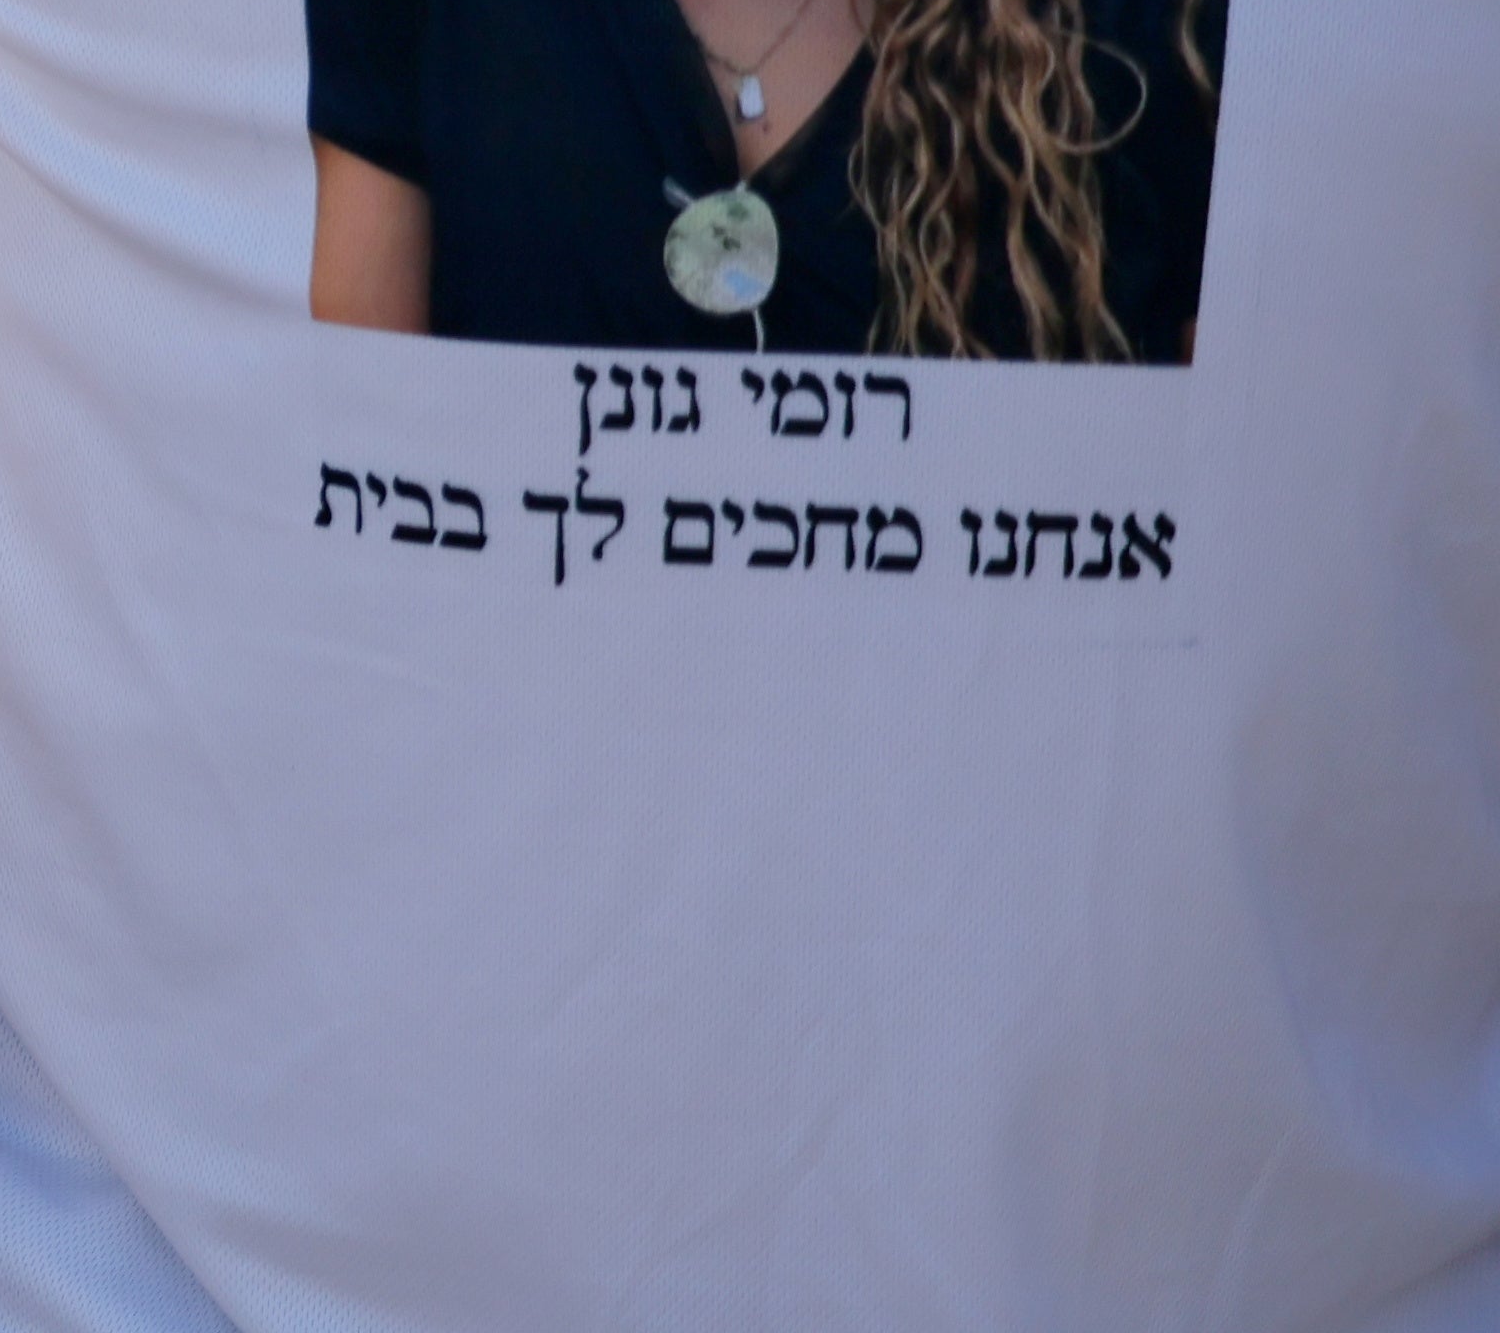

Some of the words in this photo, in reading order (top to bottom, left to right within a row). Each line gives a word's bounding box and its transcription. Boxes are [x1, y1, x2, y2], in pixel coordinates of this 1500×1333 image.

[573, 361, 700, 455] גונן
[741, 368, 912, 440] רומי
[313, 462, 487, 551] בבית
[522, 466, 625, 586] לך
[663, 496, 924, 575] מחכים
[960, 508, 1177, 580] אנחנו
